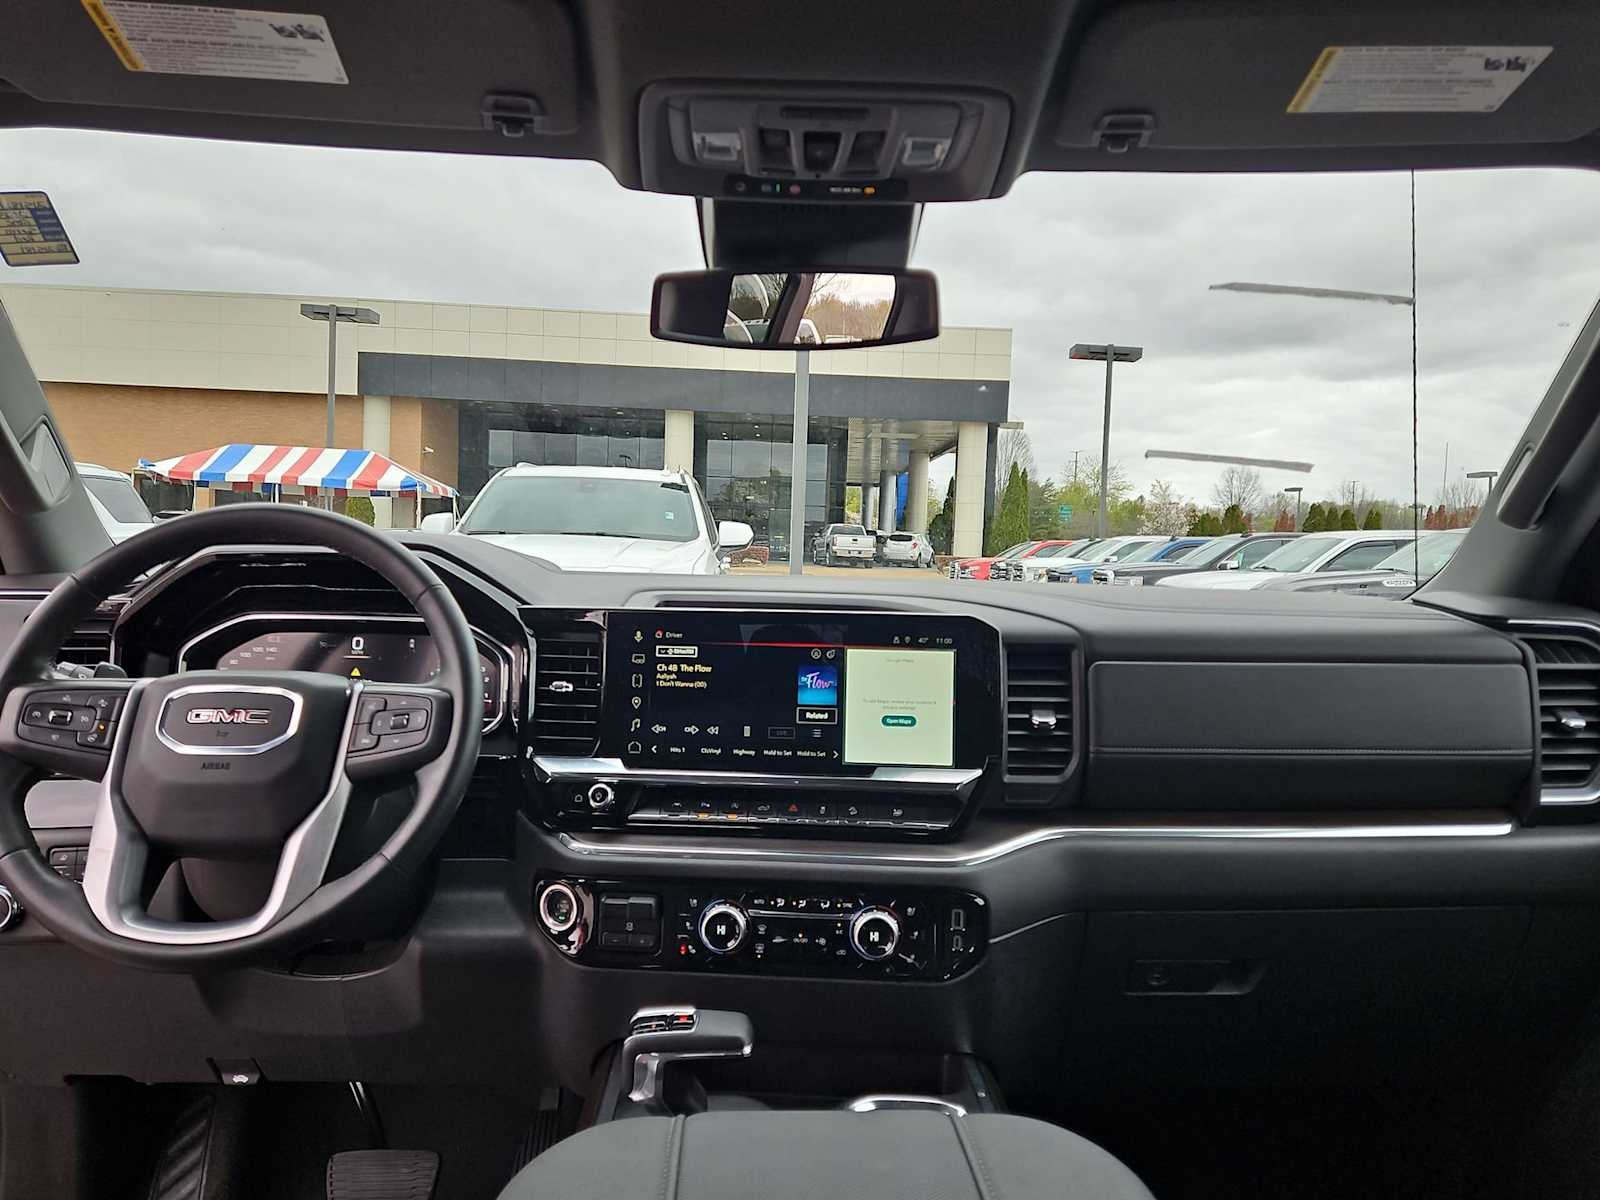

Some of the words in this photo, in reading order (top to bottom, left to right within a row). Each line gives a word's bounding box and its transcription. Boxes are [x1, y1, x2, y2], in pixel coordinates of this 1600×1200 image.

[352, 637, 364, 650] 0
[656, 663, 668, 672] Ch
[680, 664, 694, 672] The
[695, 664, 712, 673] Flow
[806, 671, 831, 689] Flow
[186, 708, 272, 724] GMC
[805, 712, 829, 720] Related
[201, 762, 231, 770] AIRBAG
